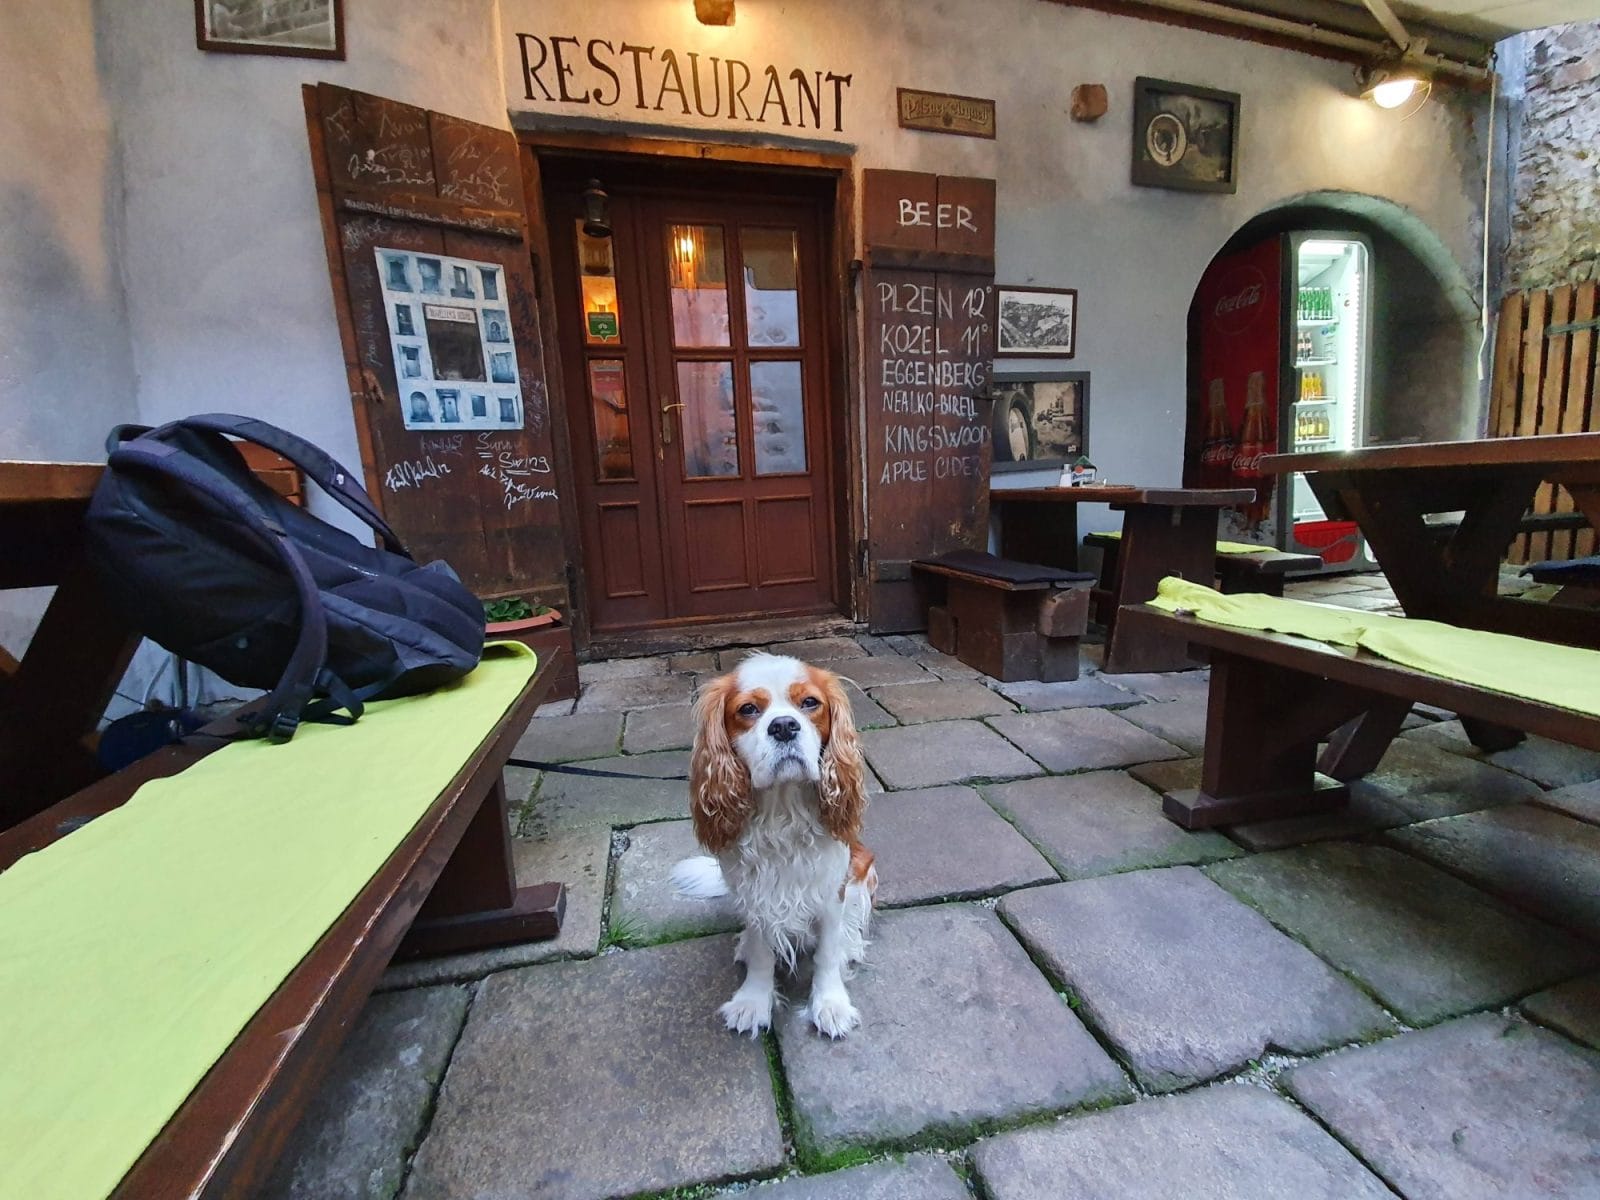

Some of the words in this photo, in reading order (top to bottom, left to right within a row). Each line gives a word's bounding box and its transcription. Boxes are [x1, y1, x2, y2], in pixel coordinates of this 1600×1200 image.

[515, 33, 853, 132] RESTAURANT
[897, 199, 978, 233] BEER
[876, 282, 953, 319] PLZEN
[880, 323, 949, 358] KOZEL
[881, 359, 985, 390] EGGENBERG
[499, 451, 551, 473] Swing
[880, 460, 927, 484] APPLE
